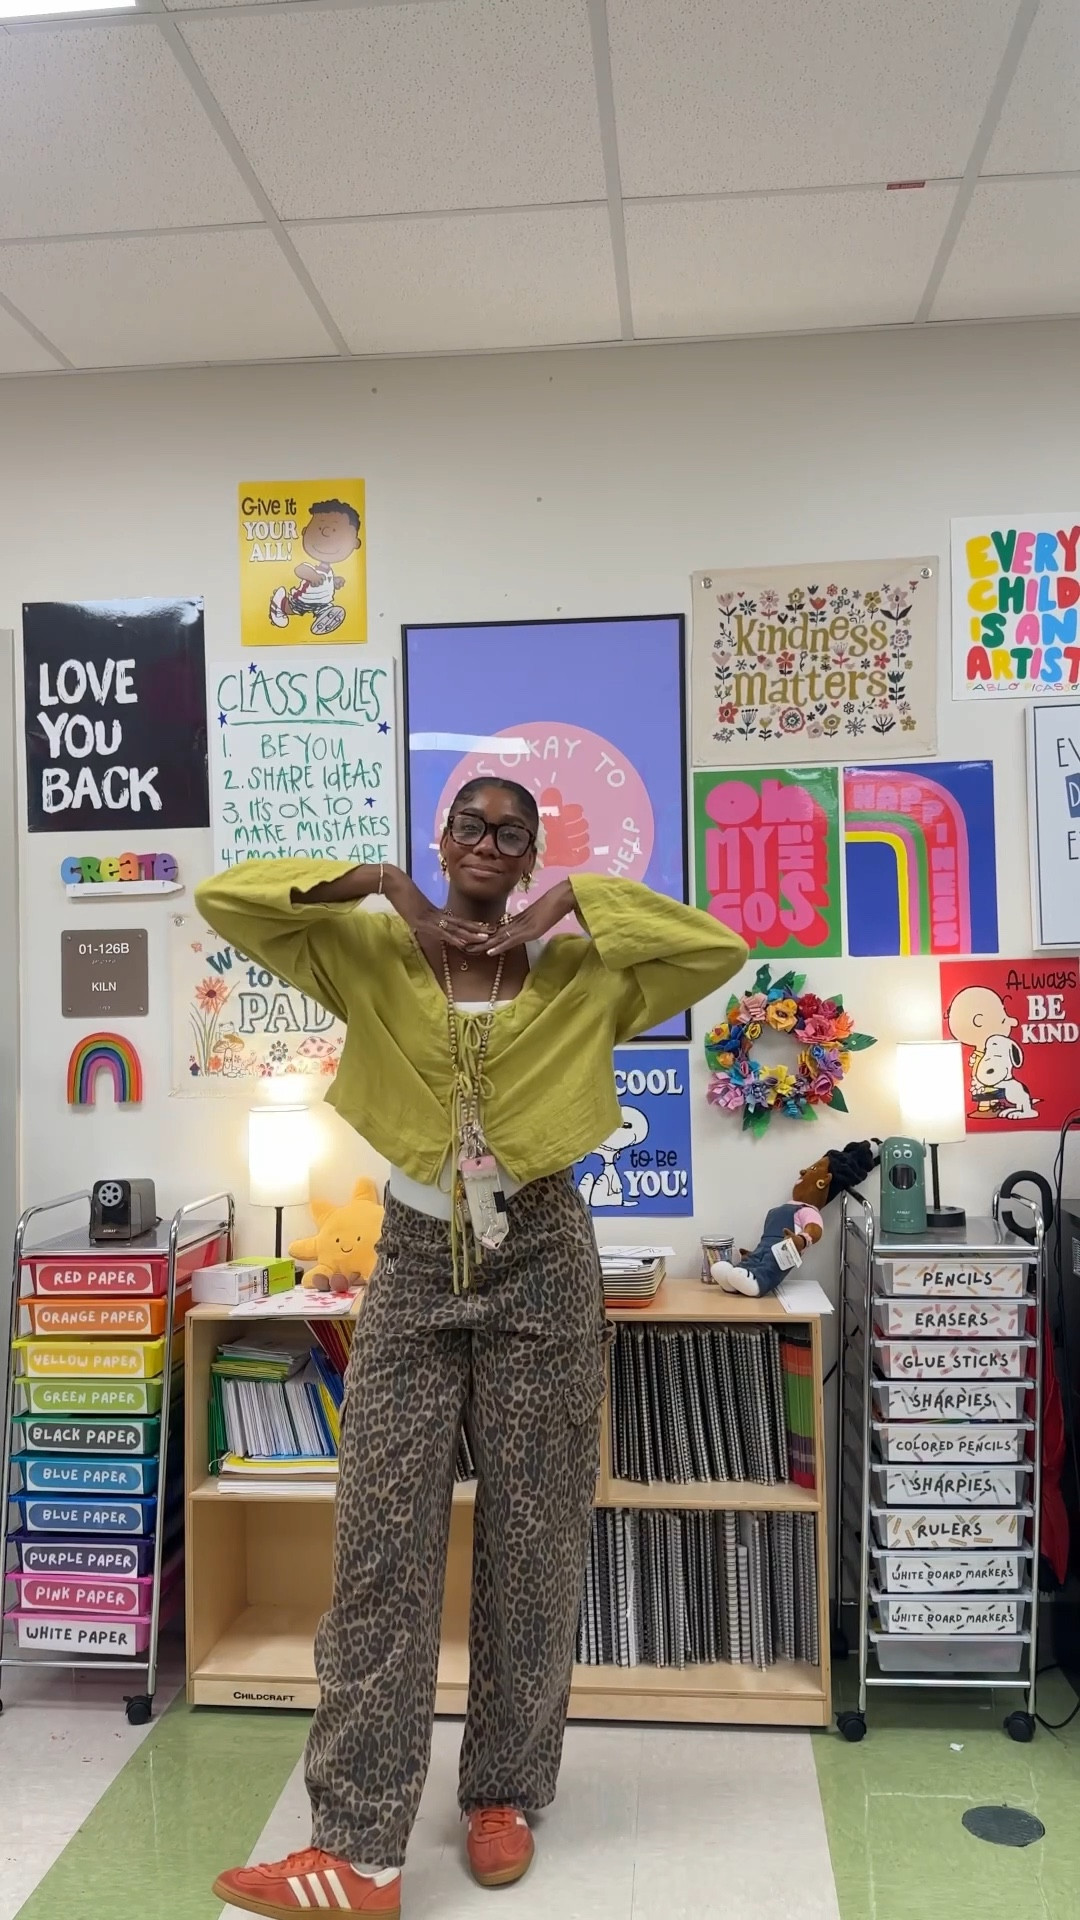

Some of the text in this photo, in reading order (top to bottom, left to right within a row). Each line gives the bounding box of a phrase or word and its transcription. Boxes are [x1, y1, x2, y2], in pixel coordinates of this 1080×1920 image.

[242, 520, 299, 540] YOUR
[249, 542, 292, 562] ALL!
[965, 526, 1080, 579] EVERY
[967, 575, 1080, 614] CHILD
[734, 612, 888, 658] kindness
[970, 608, 1078, 648] IS AN
[966, 646, 1080, 684] ARTIST
[40, 658, 138, 706] LOVE
[733, 666, 888, 708] matters
[218, 670, 308, 716] CLASS
[37, 712, 122, 758] YOU
[261, 734, 290, 759] BE
[224, 770, 244, 790] 2.
[248, 764, 314, 794] SHARE
[594, 752, 626, 788] TO
[42, 766, 162, 814] BACK
[234, 824, 287, 845] MAKE
[348, 844, 388, 864] ARE
[705, 825, 776, 891] MY
[78, 942, 130, 955] 01-126B
[91, 981, 117, 992] KILN
[246, 966, 273, 988] to
[238, 992, 336, 1034] PAD
[1026, 994, 1066, 1021] BE
[1021, 1022, 1080, 1044] KIND
[614, 1069, 683, 1096] COOL
[624, 1170, 688, 1198] YOU!
[54, 1270, 136, 1286] RED PAPER
[922, 1272, 993, 1288] PENCILS
[42, 1310, 145, 1324] ORANGE PAPER
[915, 1312, 988, 1328] ERASERS
[34, 1354, 137, 1368] YELLOW PAPER
[902, 1353, 1008, 1368] GLUE STICKS
[43, 1390, 135, 1404] GREEN PAPER
[912, 1393, 992, 1408] SHARPIES
[32, 1427, 136, 1445] BLACK PAPER
[896, 1440, 1011, 1452] COLORED PENCILS
[43, 1468, 128, 1484] BLUE PAPER
[912, 1478, 992, 1493] SHARPIES
[42, 1509, 127, 1525] BLUE PAPER
[918, 1522, 982, 1538] RULERS
[30, 1552, 132, 1568] PURPLE PAPER
[892, 1568, 1014, 1580] WHITE BOARD MARKERS
[36, 1586, 125, 1606] PINK PAPER
[892, 1614, 1014, 1623] WHITE BOARD MARKERS
[26, 1626, 128, 1646] WHITE PAPER
